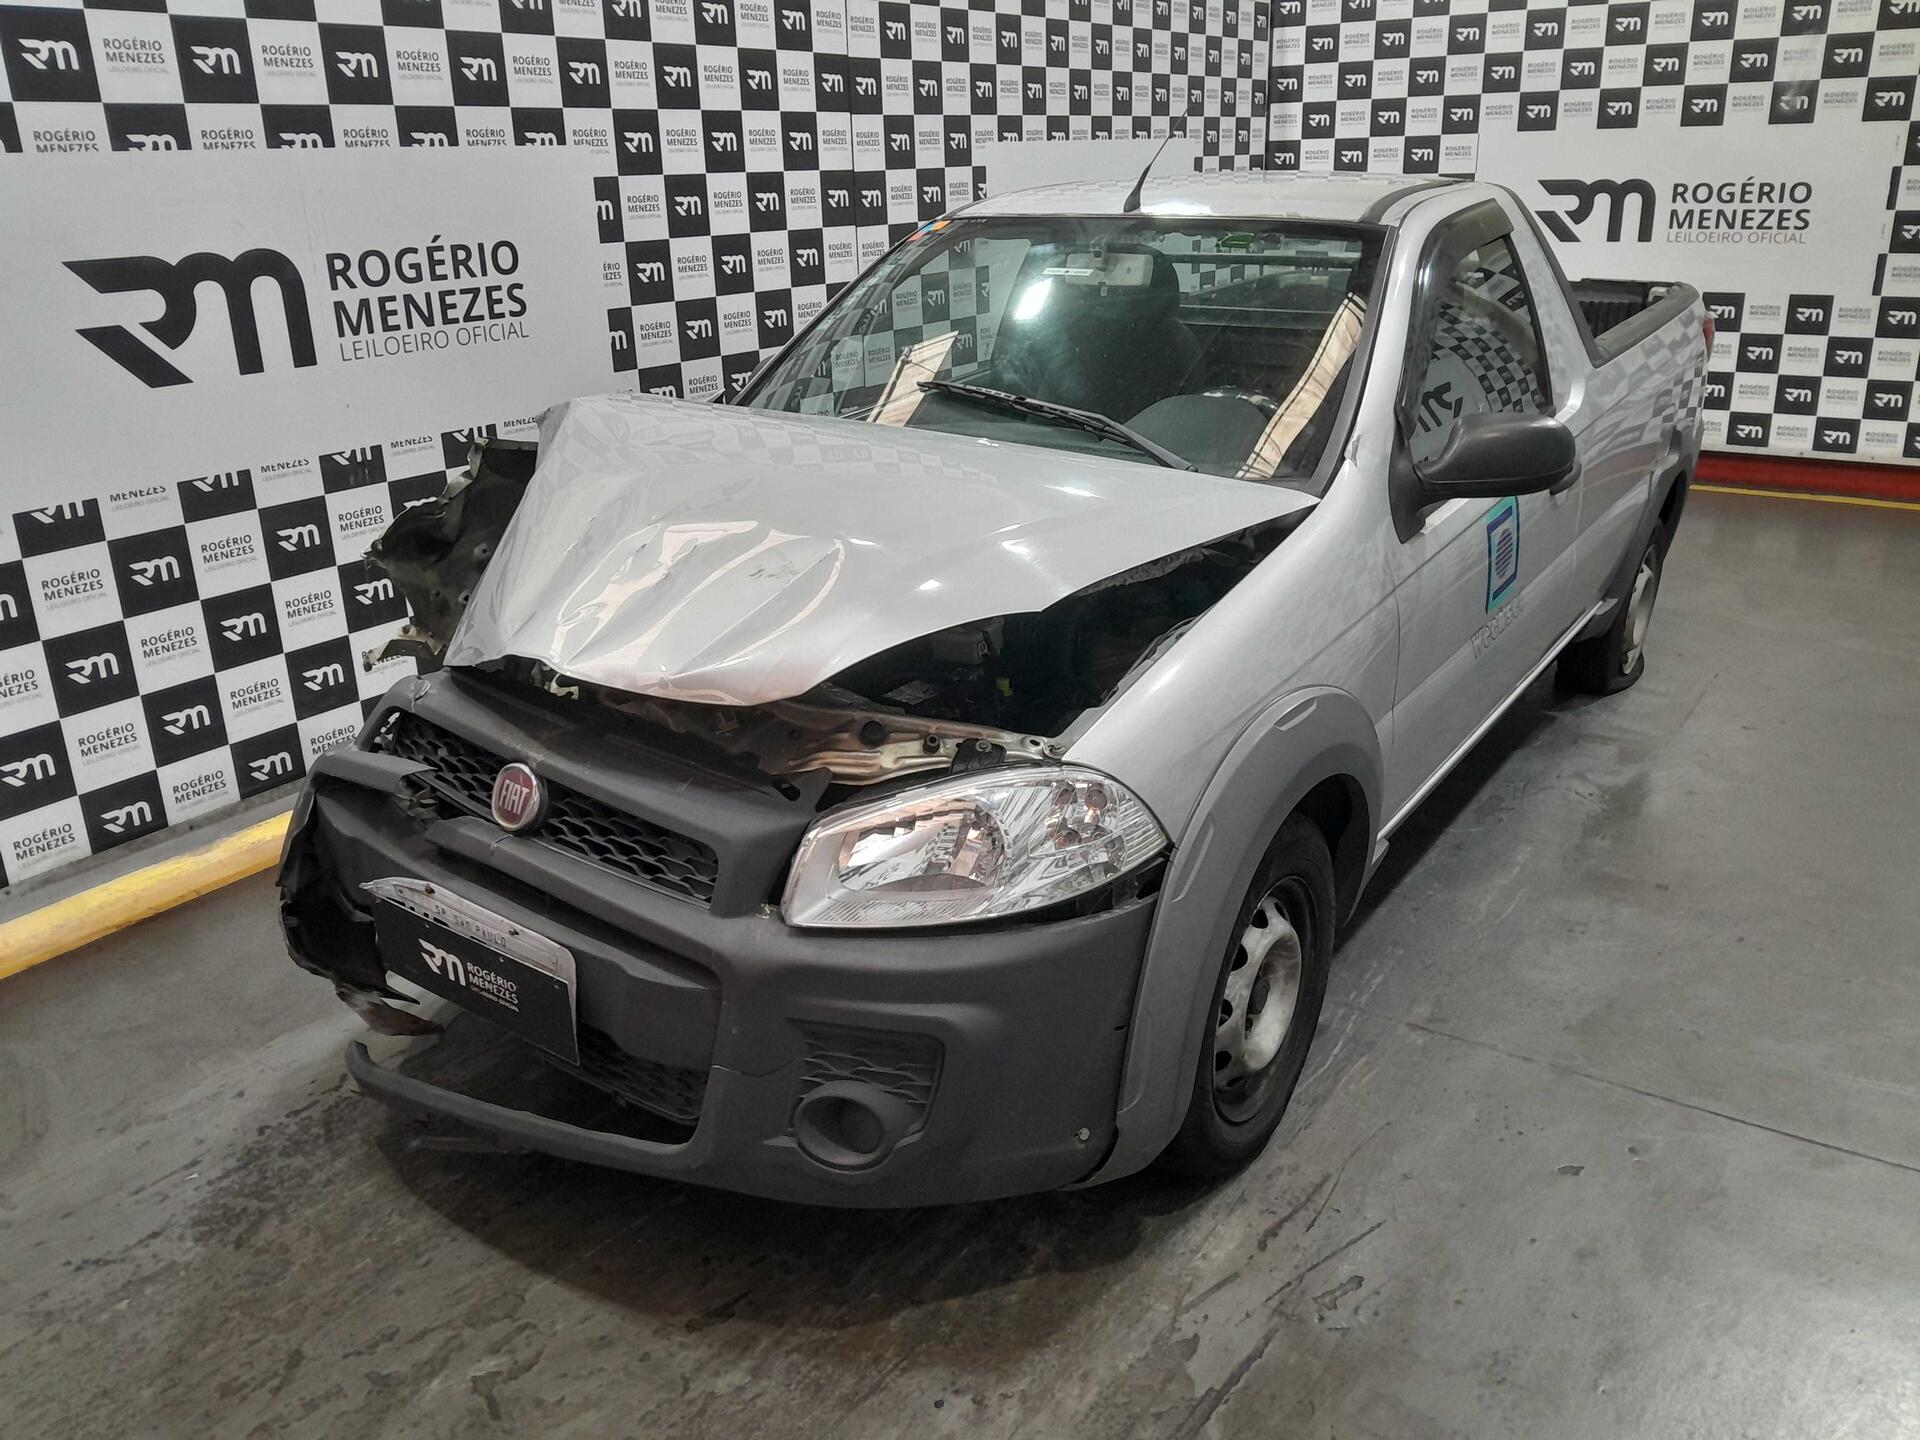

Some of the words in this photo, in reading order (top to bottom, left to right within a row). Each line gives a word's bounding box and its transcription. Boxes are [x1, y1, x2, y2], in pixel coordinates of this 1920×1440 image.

[655, 4, 688, 15] MENEZES
[740, 2, 768, 12] ROGÉRIO
[740, 11, 769, 22] MENEZES
[816, 10, 842, 20] ROGÉRIO
[816, 18, 842, 28] MENEZES
[102, 37, 162, 52] ROGÉRIO
[261, 43, 311, 57] ROGÉRIO
[105, 51, 165, 64] MENEZES
[396, 49, 439, 62] ROGÉRIO
[513, 55, 550, 66] ROGÉRIO
[263, 56, 314, 68] MENEZES
[398, 61, 441, 72] MENEZES
[614, 59, 648, 71] ROGÉRIO
[513, 65, 551, 76] MENEZES
[615, 69, 648, 80] MENEZES
[704, 64, 732, 74] ROGÉRIO
[783, 68, 809, 78] ROGÉRIO
[704, 73, 734, 82] MENEZES
[784, 76, 810, 86] MENEZES
[33, 129, 96, 142] ROGÉRIO
[201, 127, 254, 140] ROGÉRIO
[343, 126, 389, 138] ROGÉRIO
[466, 128, 505, 139] ROGÉRIO
[572, 128, 607, 138] ROGÉRIO
[666, 127, 696, 138] ROGÉRIO
[748, 127, 776, 137] ROGÉRIO
[822, 128, 846, 138] ROGÉRIO
[856, 130, 880, 139] ROGÉRIO
[666, 136, 698, 146] MENEZES
[749, 136, 776, 145] MENEZES
[822, 136, 847, 146] MENEZES
[856, 138, 880, 147] MENEZES
[713, 190, 742, 201] ROGÉRIO
[790, 188, 816, 198] ROGÉRIO
[1672, 177, 1812, 204] ROGÉRIO
[627, 192, 659, 204] ROGÉRIO
[714, 198, 743, 208] MENEZES
[790, 195, 816, 204] MENEZES
[628, 203, 660, 213] MENEZES
[1668, 209, 1810, 230] MENEZES
[1667, 231, 1741, 244] LEILOEIRO
[1747, 231, 1806, 244] OFICIAL
[757, 248, 783, 258] ROGÉRIO
[828, 242, 852, 252] ROGÉRIO
[677, 254, 706, 265] ROGÉRIO
[828, 250, 853, 258] MENEZES
[325, 235, 519, 291] ROGÉRIO
[757, 256, 784, 265] MENEZES
[678, 264, 708, 274] MENEZES
[333, 283, 528, 338] MENEZES
[798, 301, 822, 311] ROGÉRIO
[723, 310, 750, 322] ROGÉRIO
[640, 320, 670, 332] ROGÉRIO
[724, 318, 752, 329] MENEZES
[339, 329, 450, 361] LEILOEIRO
[456, 320, 530, 345] OFICIAL
[640, 330, 672, 341] MENEZES
[688, 374, 718, 386] ROGÉRIO
[689, 382, 718, 394] MENEZES
[338, 505, 382, 523] ROGÉRIO
[339, 515, 384, 532] MENEZES
[201, 534, 252, 554] ROGÉRIO
[202, 544, 255, 564] MENEZES
[41, 568, 101, 591] ROGÉRIO
[44, 579, 104, 601] MENEZES
[285, 589, 332, 609] ROGÉRIO
[287, 599, 334, 619] MENEZES
[141, 626, 194, 648] ROGÉRIO
[143, 636, 198, 659] MENEZES
[230, 678, 279, 700] ROGÉRIO
[232, 687, 281, 709] MENEZES
[78, 722, 135, 748] ROGÉRIO
[310, 724, 355, 747] ROGÉRIO
[81, 732, 138, 758] MENEZES
[172, 770, 224, 795] ROGÉRIO
[175, 779, 226, 804] MENEZES
[500, 779, 530, 815] FIAT
[13, 823, 72, 850] ROGÉRIO
[16, 833, 76, 861] MENEZES
[475, 924, 507, 948] PAULO
[467, 962, 516, 992] ROGÉRIO
[469, 974, 518, 1004] MENEZES
